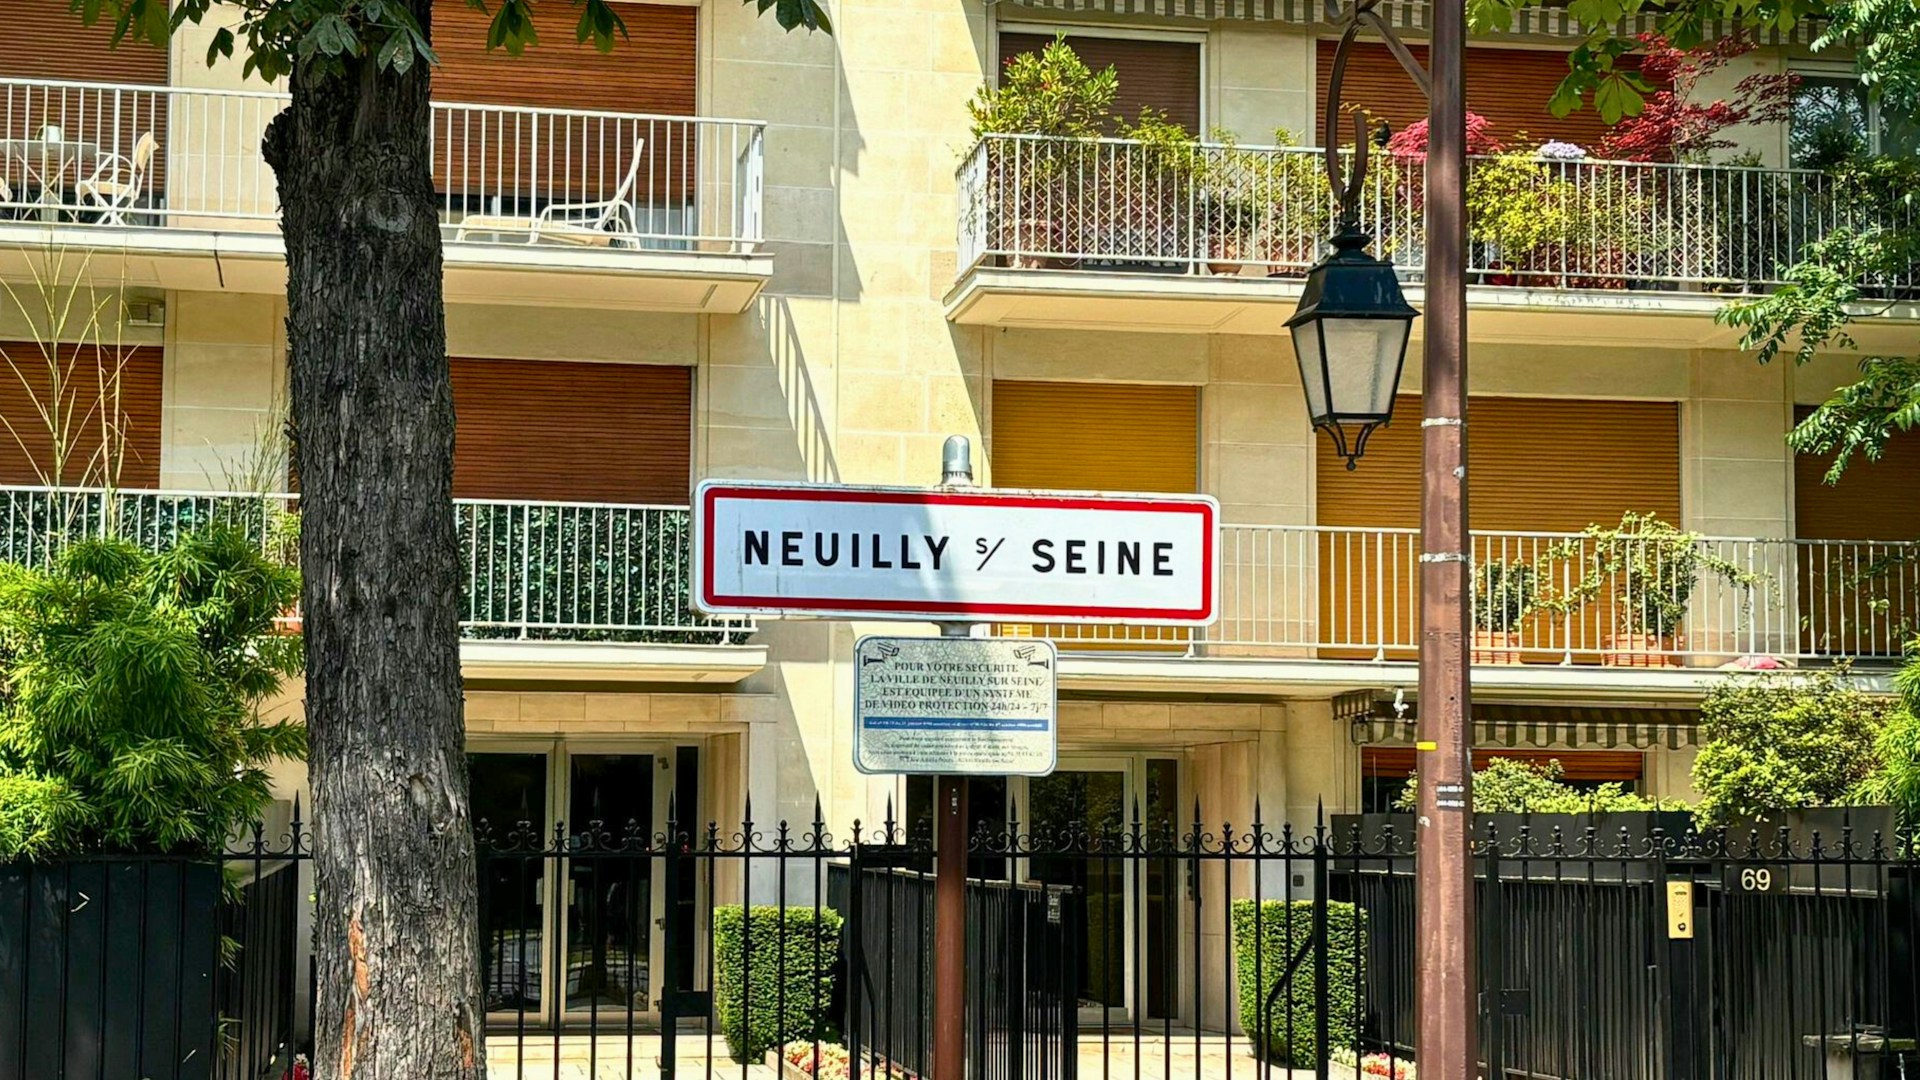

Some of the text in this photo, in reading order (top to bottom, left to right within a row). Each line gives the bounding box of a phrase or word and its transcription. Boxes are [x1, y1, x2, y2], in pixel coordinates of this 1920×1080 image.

[744, 530, 949, 571] NEUILLY
[1031, 539, 1174, 576] SEINE
[894, 662, 924, 672] POUR
[926, 662, 964, 673] VOTRE
[871, 674, 1044, 687] LA VILLE DE NEUILLY SUR SEINE
[882, 687, 904, 697] EST
[865, 699, 880, 709] DE
[919, 701, 989, 711] PROTECTION
[1740, 867, 1772, 892] 69
